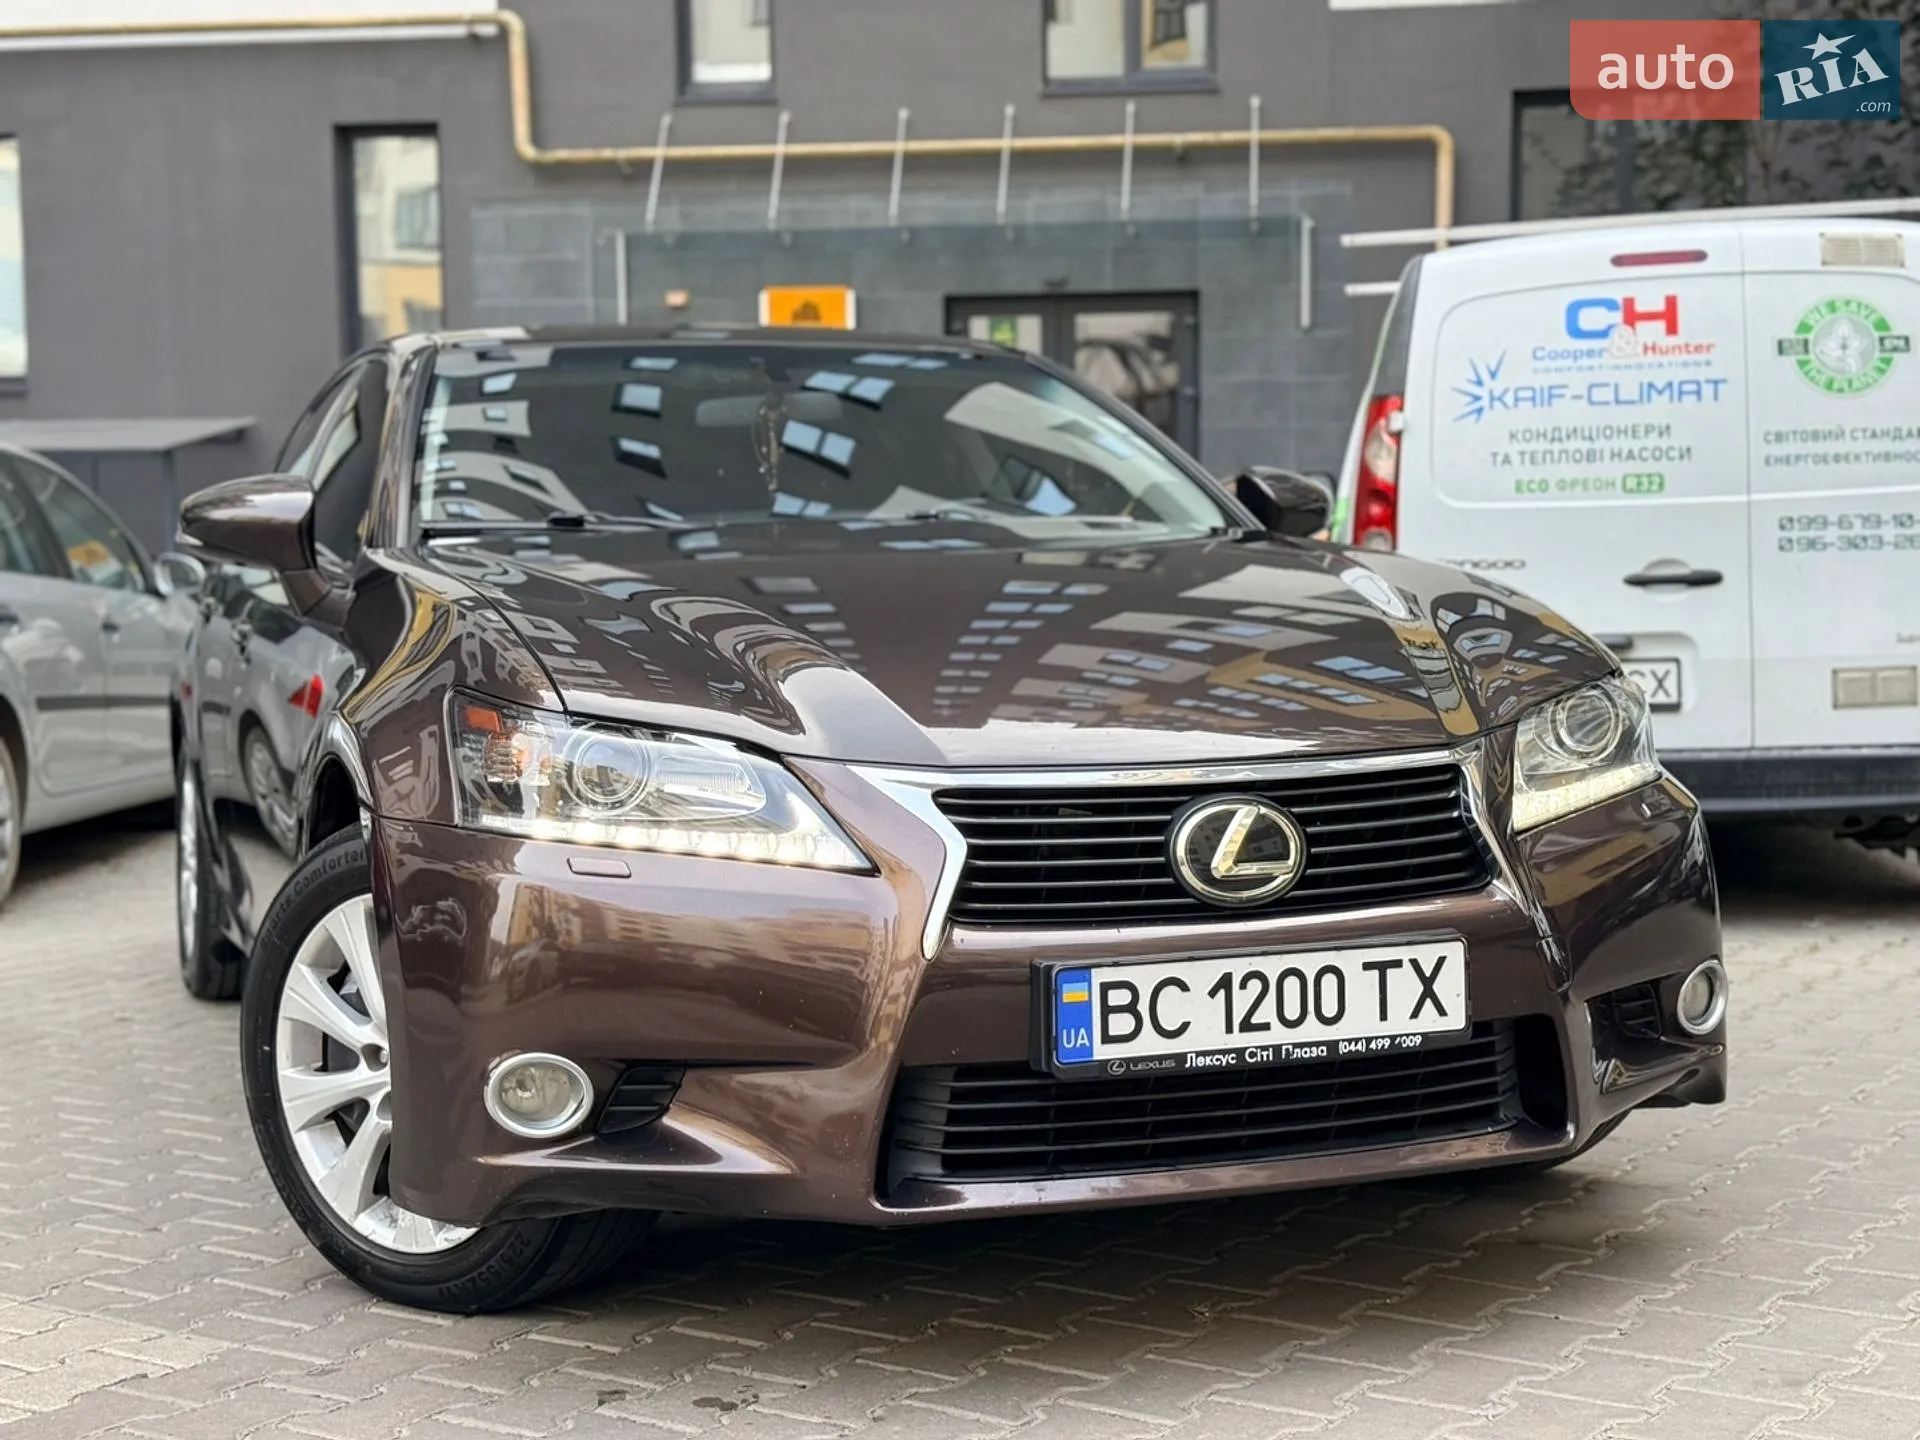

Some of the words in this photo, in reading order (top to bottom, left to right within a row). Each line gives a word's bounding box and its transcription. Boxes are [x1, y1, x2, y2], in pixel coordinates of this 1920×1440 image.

[1532, 345, 1607, 363] Cooper
[1641, 340, 1715, 357] Hunter
[1489, 379, 1728, 410] KAIF-CLIMAT
[1508, 422, 1672, 444] КОНДИЦІОНЕРИ
[1763, 425, 1846, 444] СВІТОВИЙ
[1490, 452, 1513, 467] ТА
[1519, 448, 1604, 466] ТЕПЛОВІ
[1610, 445, 1692, 463] НАСОСИ
[1514, 478, 1550, 494] ECO
[1555, 477, 1617, 492] ФРЕОН
[1099, 976, 1191, 1045] BC
[1207, 964, 1346, 1034] 1200
[1362, 955, 1448, 1022] TX
[1062, 1026, 1089, 1048] UA
[1130, 1059, 1175, 1071] LEXUS
[1185, 1052, 1237, 1069] Лексус
[1244, 1047, 1273, 1063] Сіті
[1281, 1043, 1327, 1060] Плаза
[1338, 1039, 1366, 1055] (044)
[1369, 1037, 1391, 1052] 499
